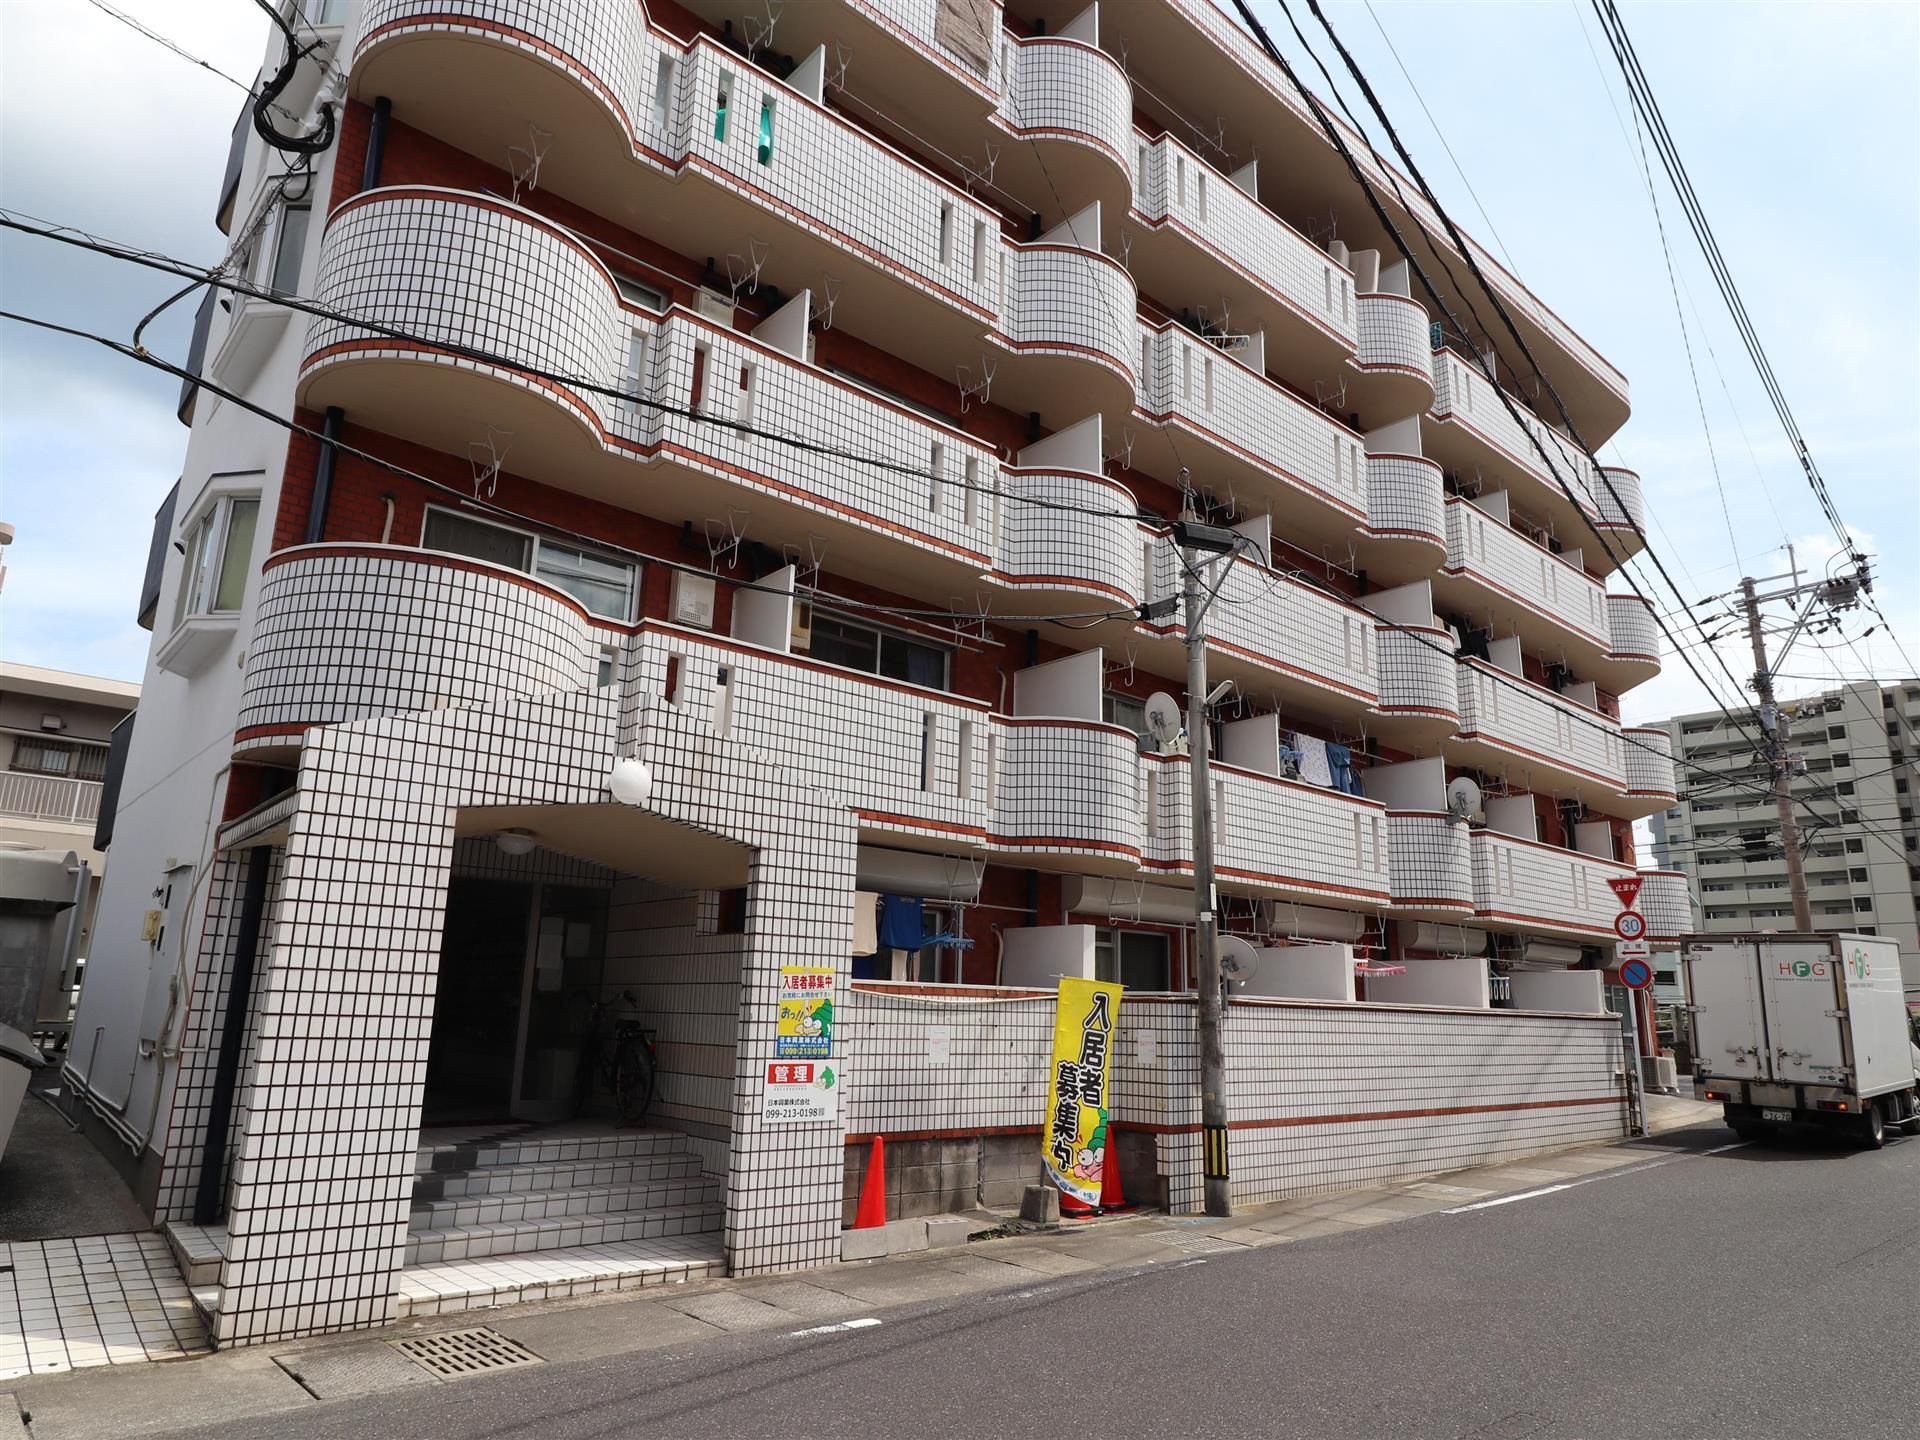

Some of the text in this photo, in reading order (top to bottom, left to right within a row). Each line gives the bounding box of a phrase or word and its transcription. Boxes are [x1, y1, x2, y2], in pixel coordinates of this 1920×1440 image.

[1615, 883, 1638, 892] 止まれ
[1621, 919, 1639, 933] 30
[1779, 961, 1825, 977] HFG
[782, 975, 833, 990] 入居者募集中
[1079, 991, 1112, 1108] 入居者
[774, 1065, 808, 1082] 管理
[765, 1107, 818, 1119] 099-213-0198
